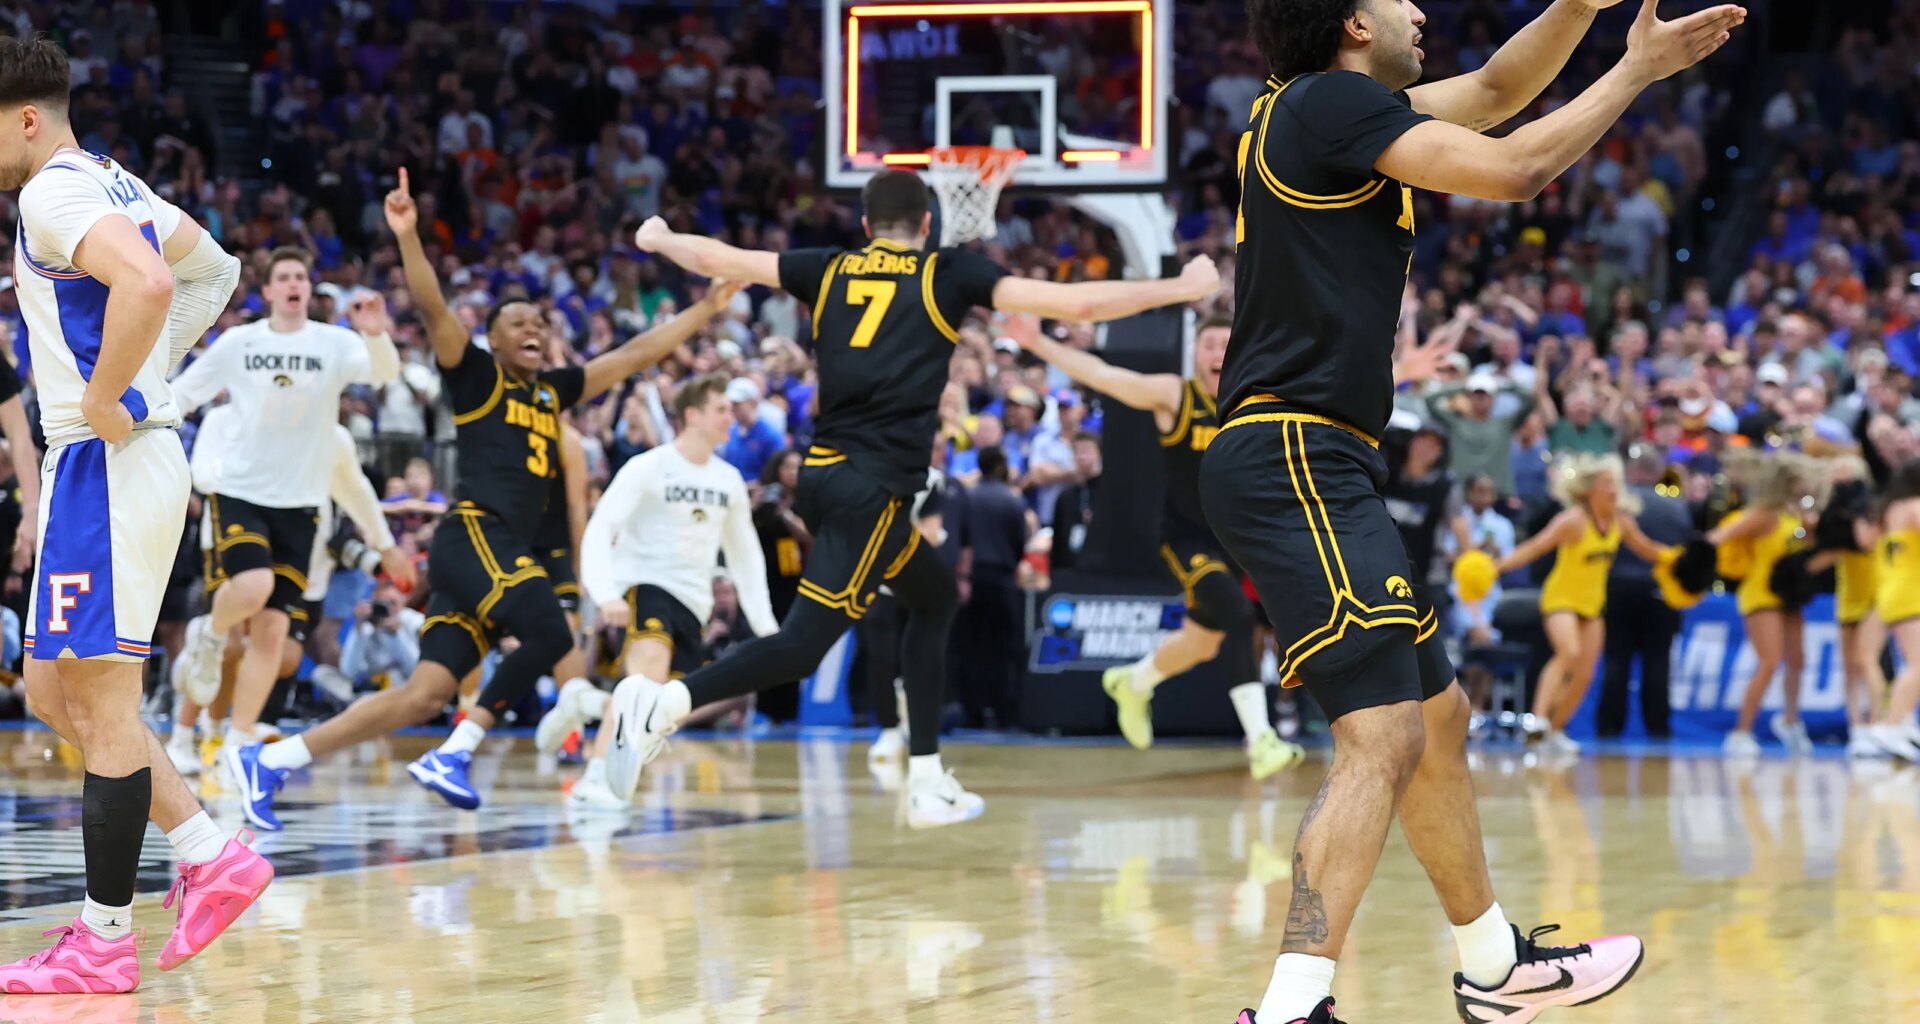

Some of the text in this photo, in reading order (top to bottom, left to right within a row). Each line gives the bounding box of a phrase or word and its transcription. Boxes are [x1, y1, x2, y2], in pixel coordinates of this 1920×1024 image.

[846, 279, 897, 348] 7
[244, 354, 323, 372] LOCK IT IN
[527, 432, 549, 477] 3
[665, 486, 699, 503] LOCK
[48, 572, 93, 634] F
[1073, 601, 1163, 630] MARCH
